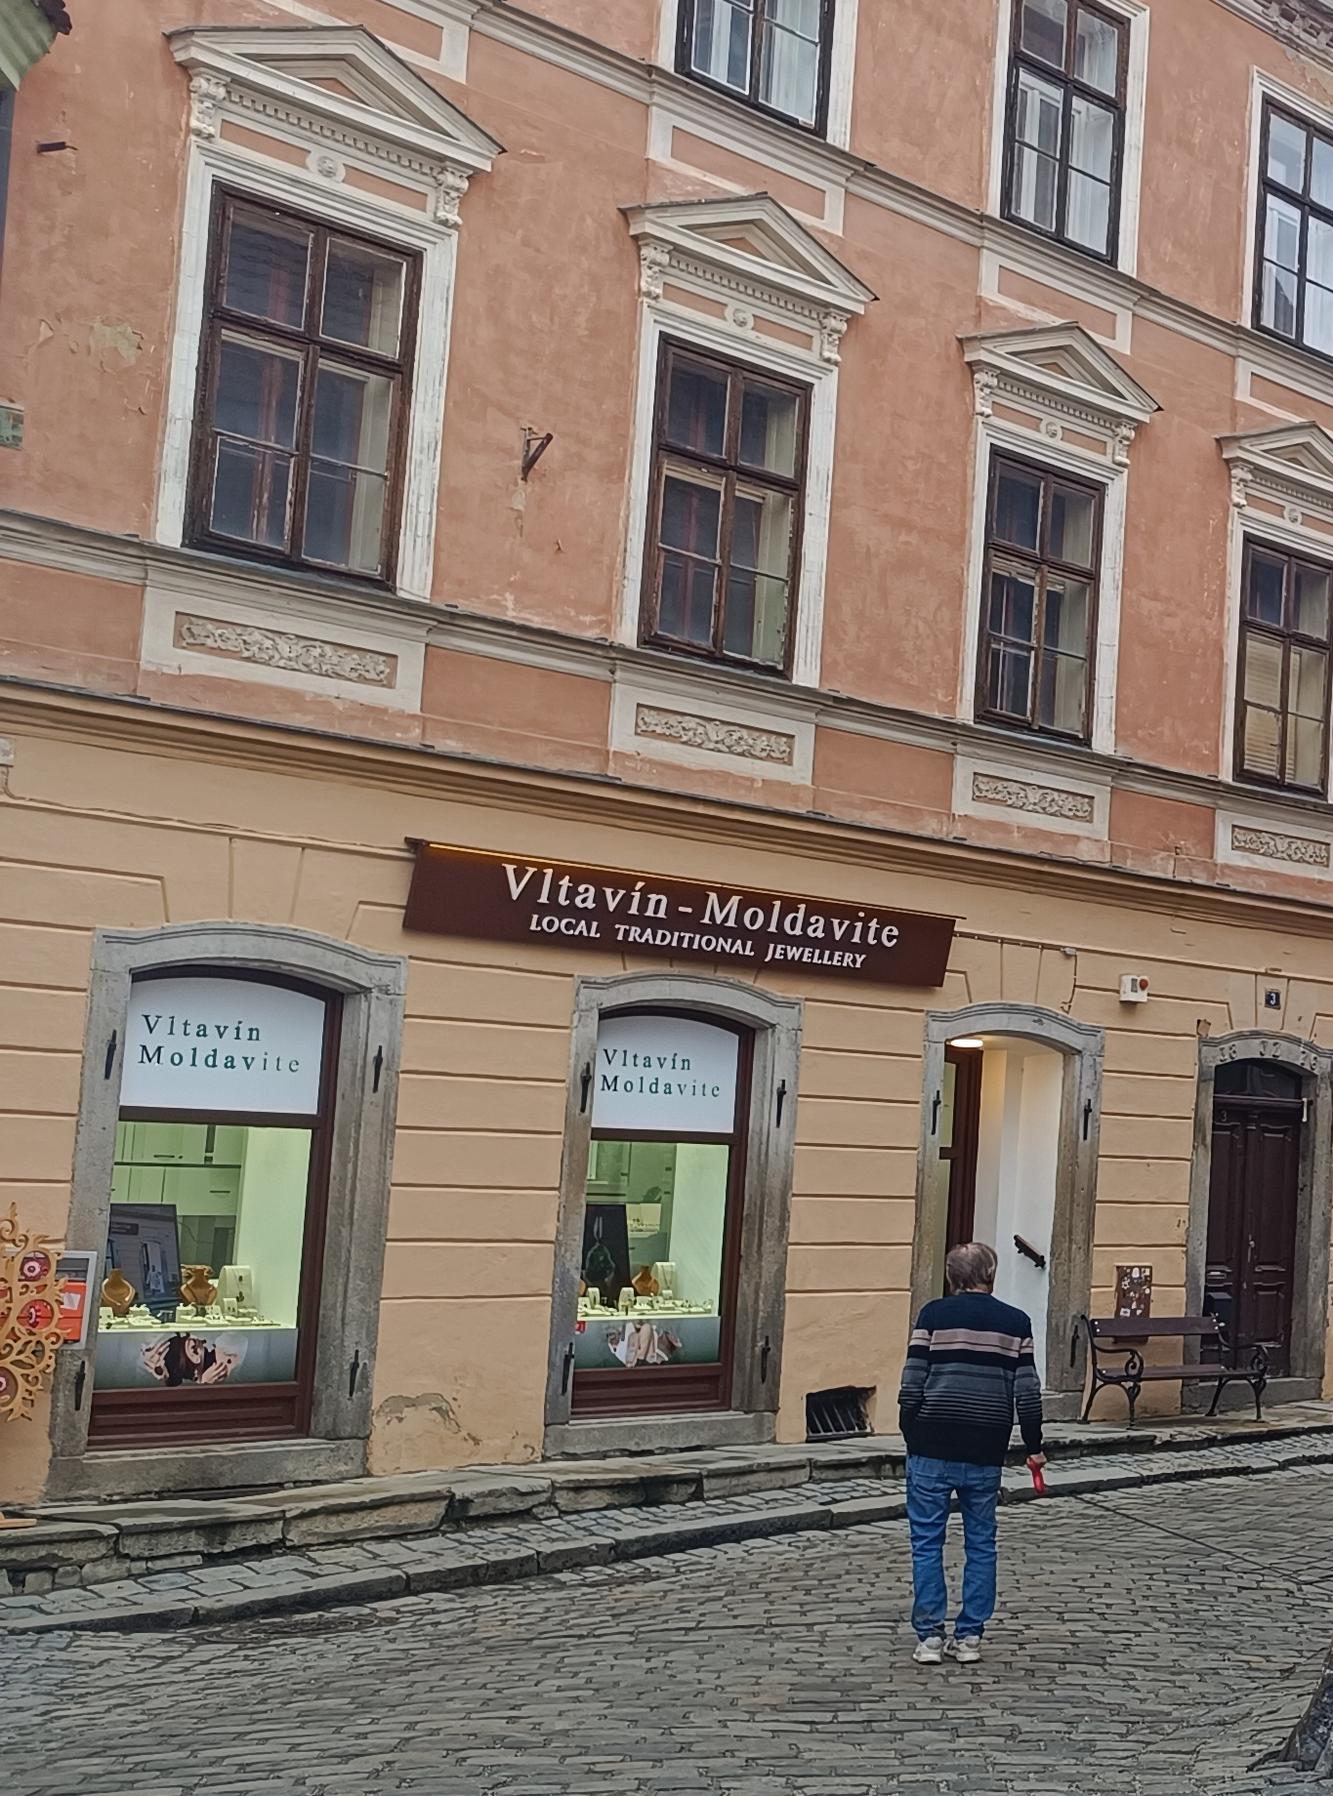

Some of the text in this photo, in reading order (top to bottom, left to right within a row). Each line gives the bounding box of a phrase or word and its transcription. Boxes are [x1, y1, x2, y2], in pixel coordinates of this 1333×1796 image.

[701, 891, 899, 948] Moldavite
[529, 914, 867, 970] LOCAL TRADITIONAL JEWELLERY
[141, 1013, 262, 1042] Vltavín
[138, 1044, 300, 1073] Moldavite
[602, 1048, 692, 1071] Vltavín
[600, 1074, 720, 1098] Moldavite
